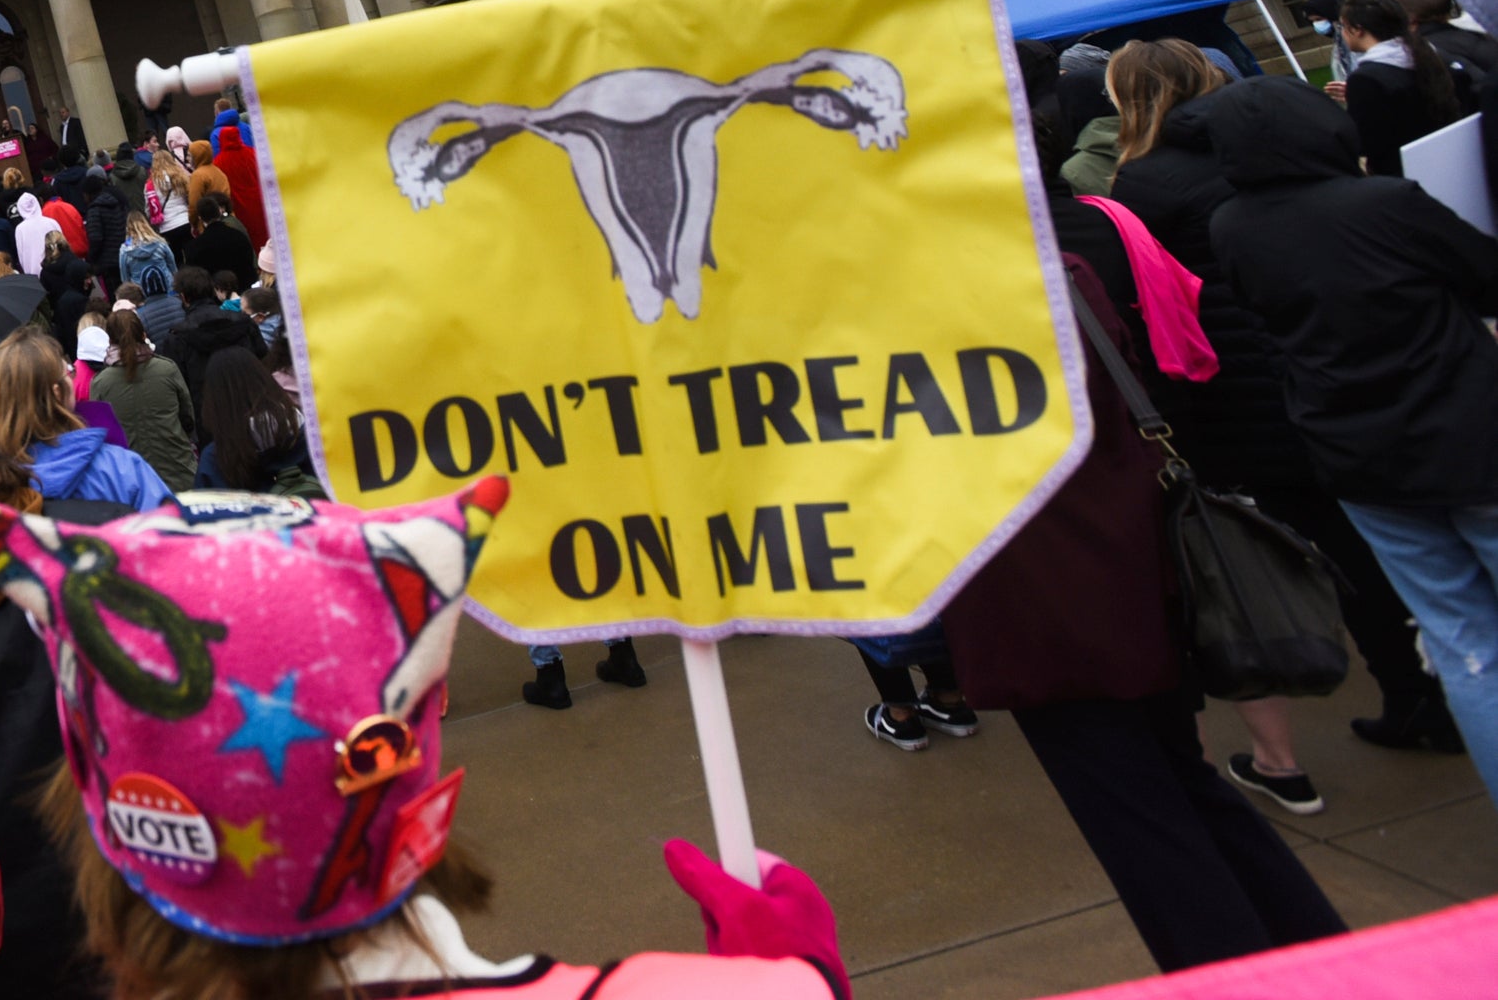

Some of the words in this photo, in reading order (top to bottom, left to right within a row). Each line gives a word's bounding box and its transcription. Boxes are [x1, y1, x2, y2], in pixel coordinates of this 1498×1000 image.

[347, 375, 643, 493] DON'T
[667, 346, 1048, 455] TREAD
[549, 513, 683, 601] ON
[706, 501, 867, 600] ME
[113, 809, 208, 857] VOTE
